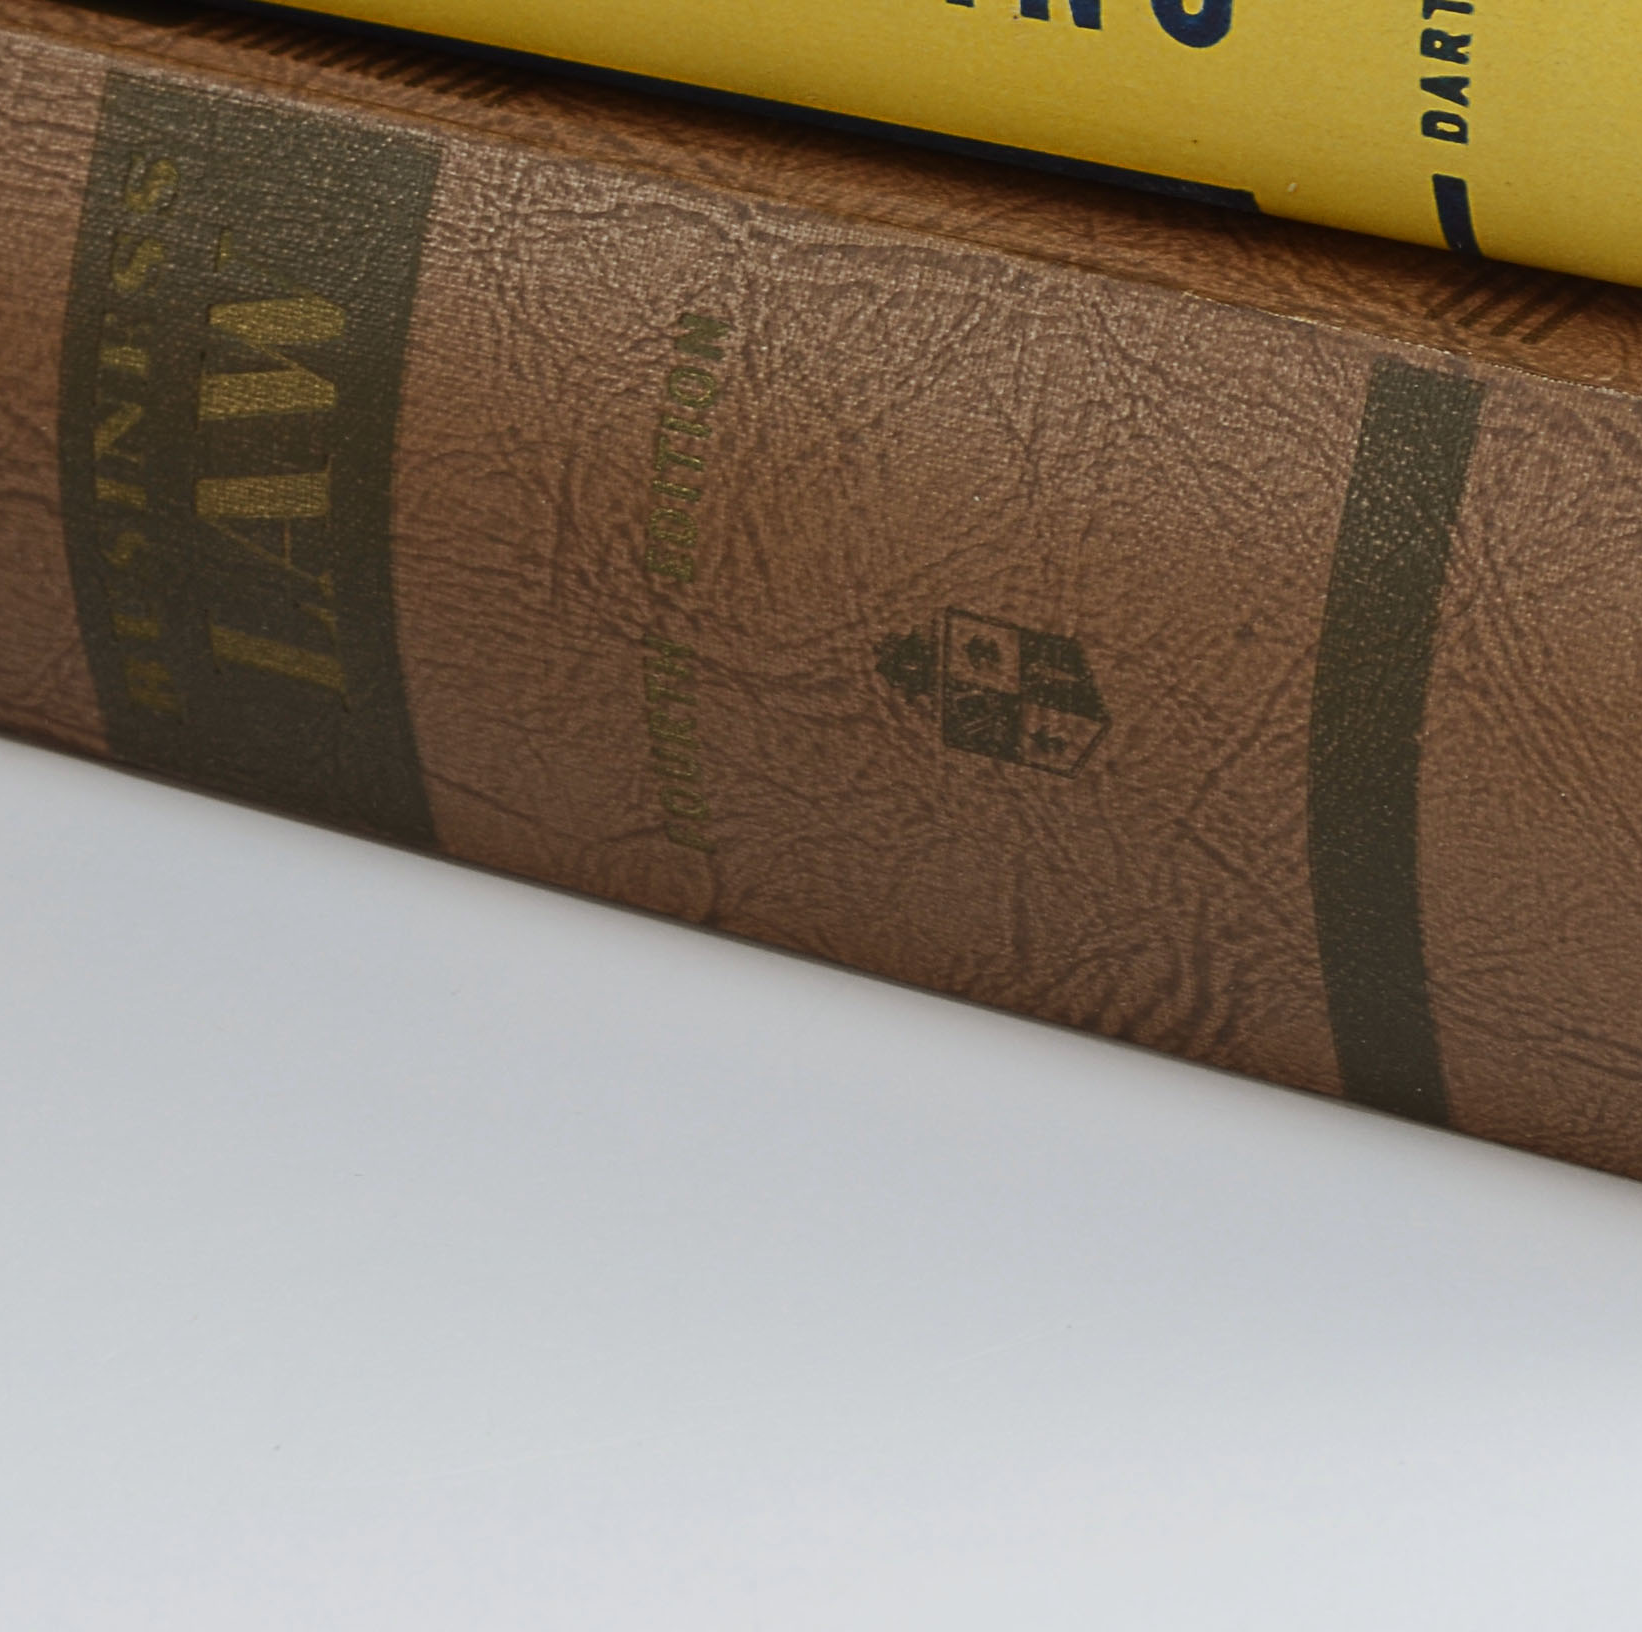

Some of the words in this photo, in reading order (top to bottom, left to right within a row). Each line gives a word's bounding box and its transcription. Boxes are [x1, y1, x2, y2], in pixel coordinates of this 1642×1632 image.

[93, 156, 185, 725] BUSINESS
[193, 226, 351, 711] LAW
[644, 312, 732, 584] EDITION
